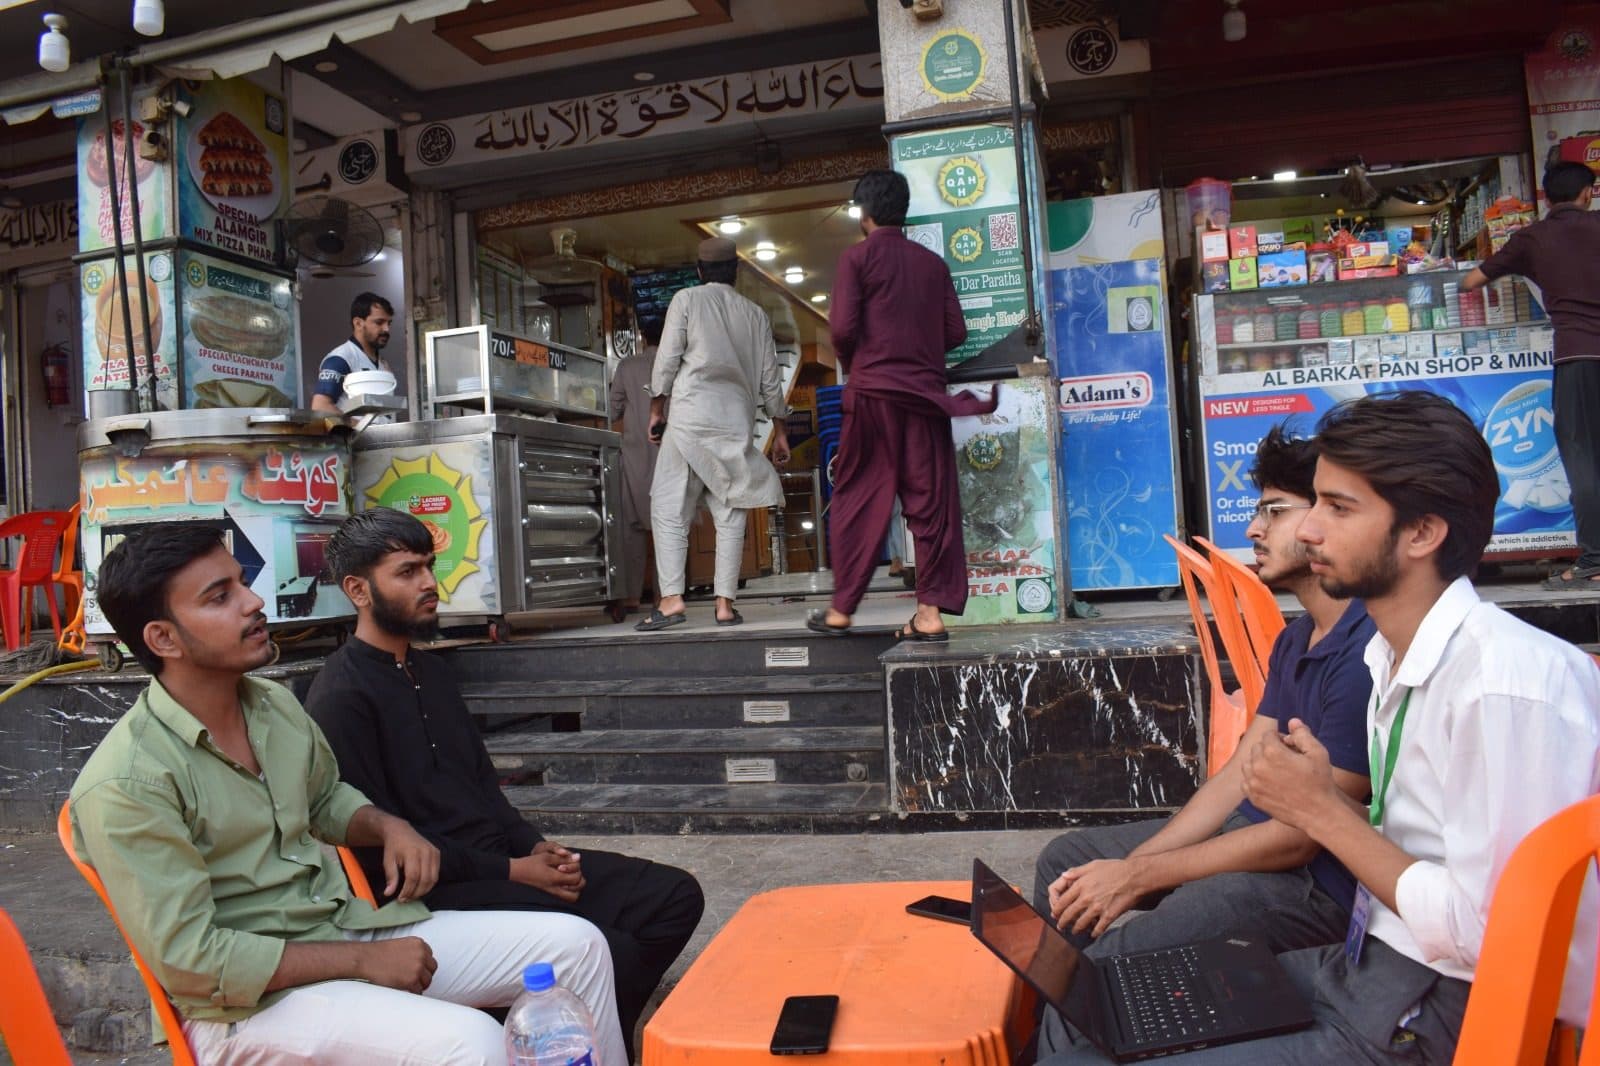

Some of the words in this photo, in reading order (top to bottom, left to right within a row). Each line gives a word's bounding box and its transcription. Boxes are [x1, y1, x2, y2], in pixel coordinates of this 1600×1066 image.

[218, 203, 260, 228] SPECIAL
[214, 216, 267, 246] ALAMGIR
[194, 226, 213, 243] MIX
[216, 234, 245, 254] PIZZA
[960, 277, 980, 291] Dar
[982, 271, 1021, 288] Paratha
[199, 348, 230, 362] SPECIAL
[492, 338, 515, 357] 70/-
[100, 354, 161, 370] ALAGR
[550, 352, 566, 368] 70/-
[212, 364, 238, 376] CHEESE
[240, 369, 274, 382] PARATHA
[1263, 372, 1287, 388] AL
[1293, 364, 1374, 385] BARKAT
[1380, 360, 1420, 378] PAN
[1426, 356, 1484, 375] SHOP
[1490, 354, 1504, 370] &
[1065, 380, 1141, 404] Adam's
[1210, 400, 1249, 416] NEW
[1252, 398, 1282, 406] DESIGNED
[1522, 398, 1539, 408] Mint
[1068, 412, 1085, 424] For
[1086, 411, 1120, 424] Healthy
[1122, 409, 1142, 421] Life!
[1492, 406, 1555, 446] ZYN
[1216, 498, 1234, 509] Or
[1498, 536, 1521, 544] which
[1530, 534, 1568, 542] addictive.
[968, 548, 1030, 561] ECIAL
[967, 564, 1042, 578] SHMIRI
[968, 582, 1009, 596] TEA
